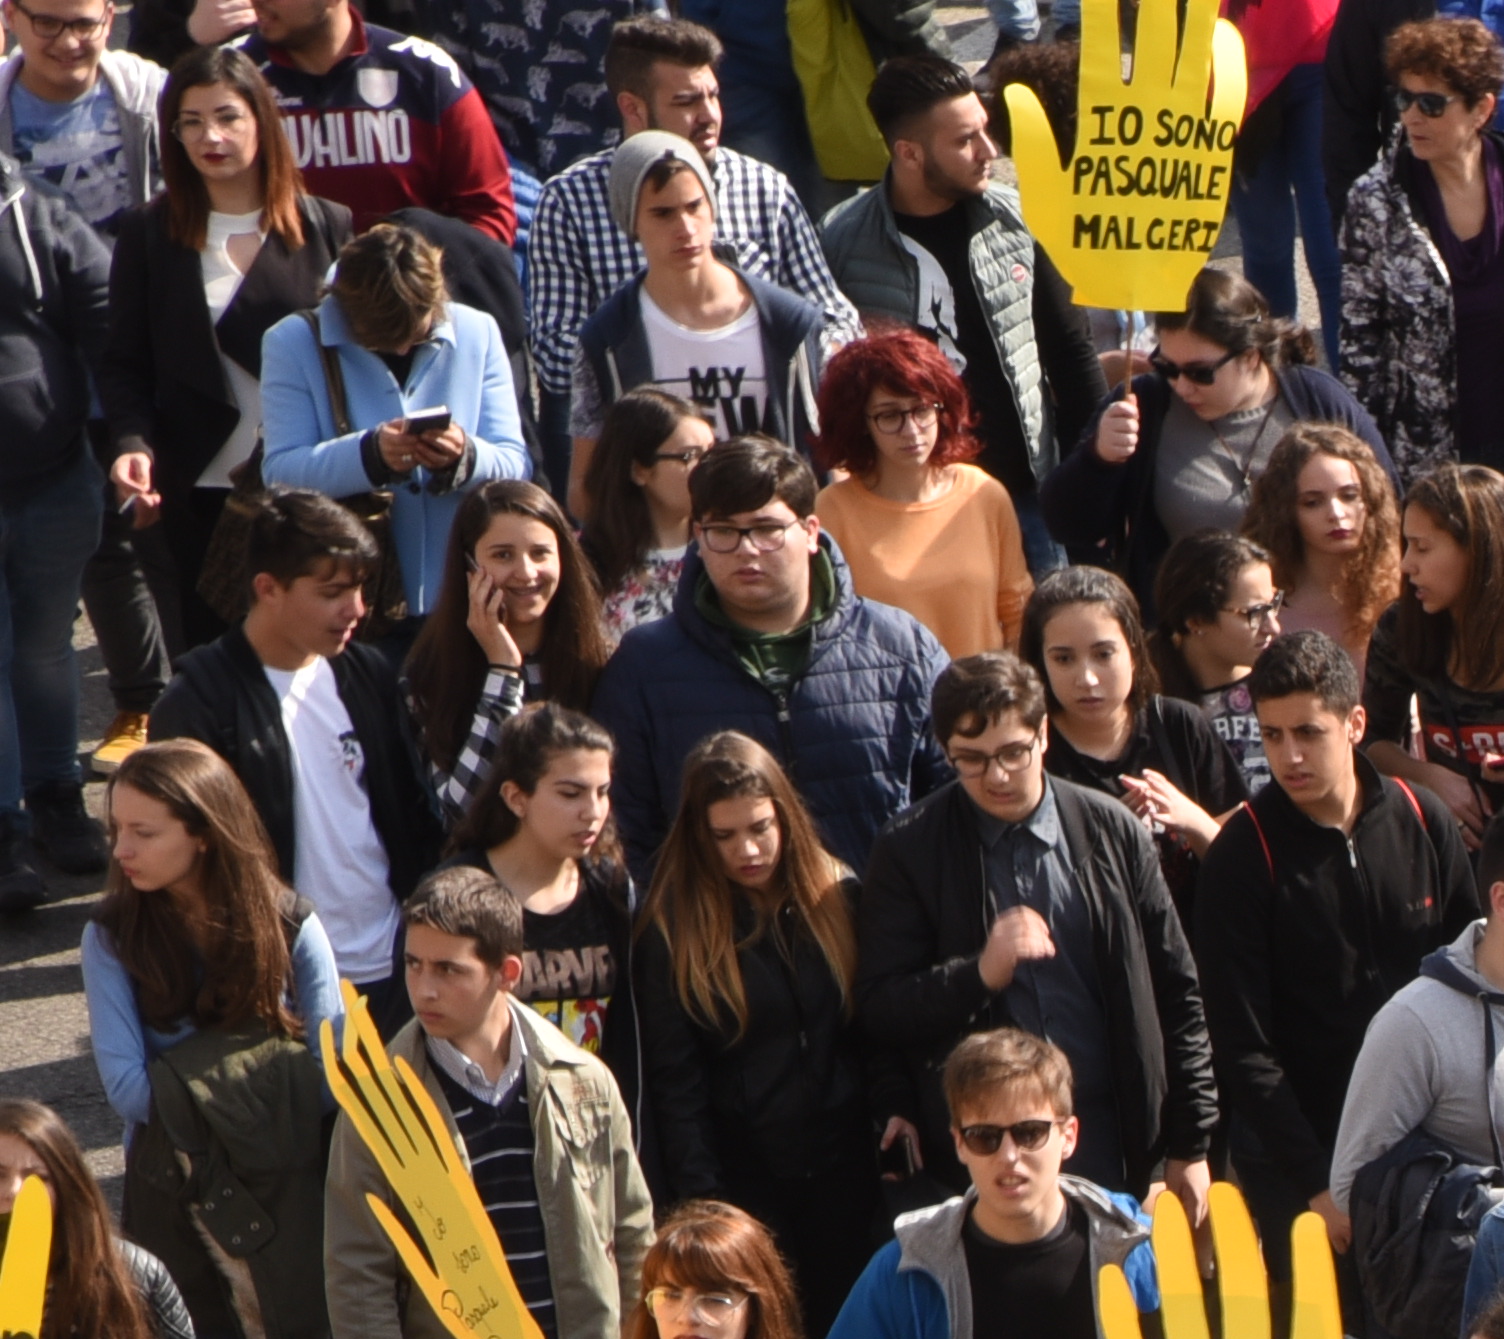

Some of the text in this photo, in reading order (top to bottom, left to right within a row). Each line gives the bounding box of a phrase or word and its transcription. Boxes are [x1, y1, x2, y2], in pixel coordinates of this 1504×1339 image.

[281, 110, 411, 169] VALINO
[1090, 106, 1236, 152] IO SONO
[1073, 156, 1226, 201] PASQUALE
[1073, 215, 1218, 254] MALGERI
[690, 367, 747, 399] MY
